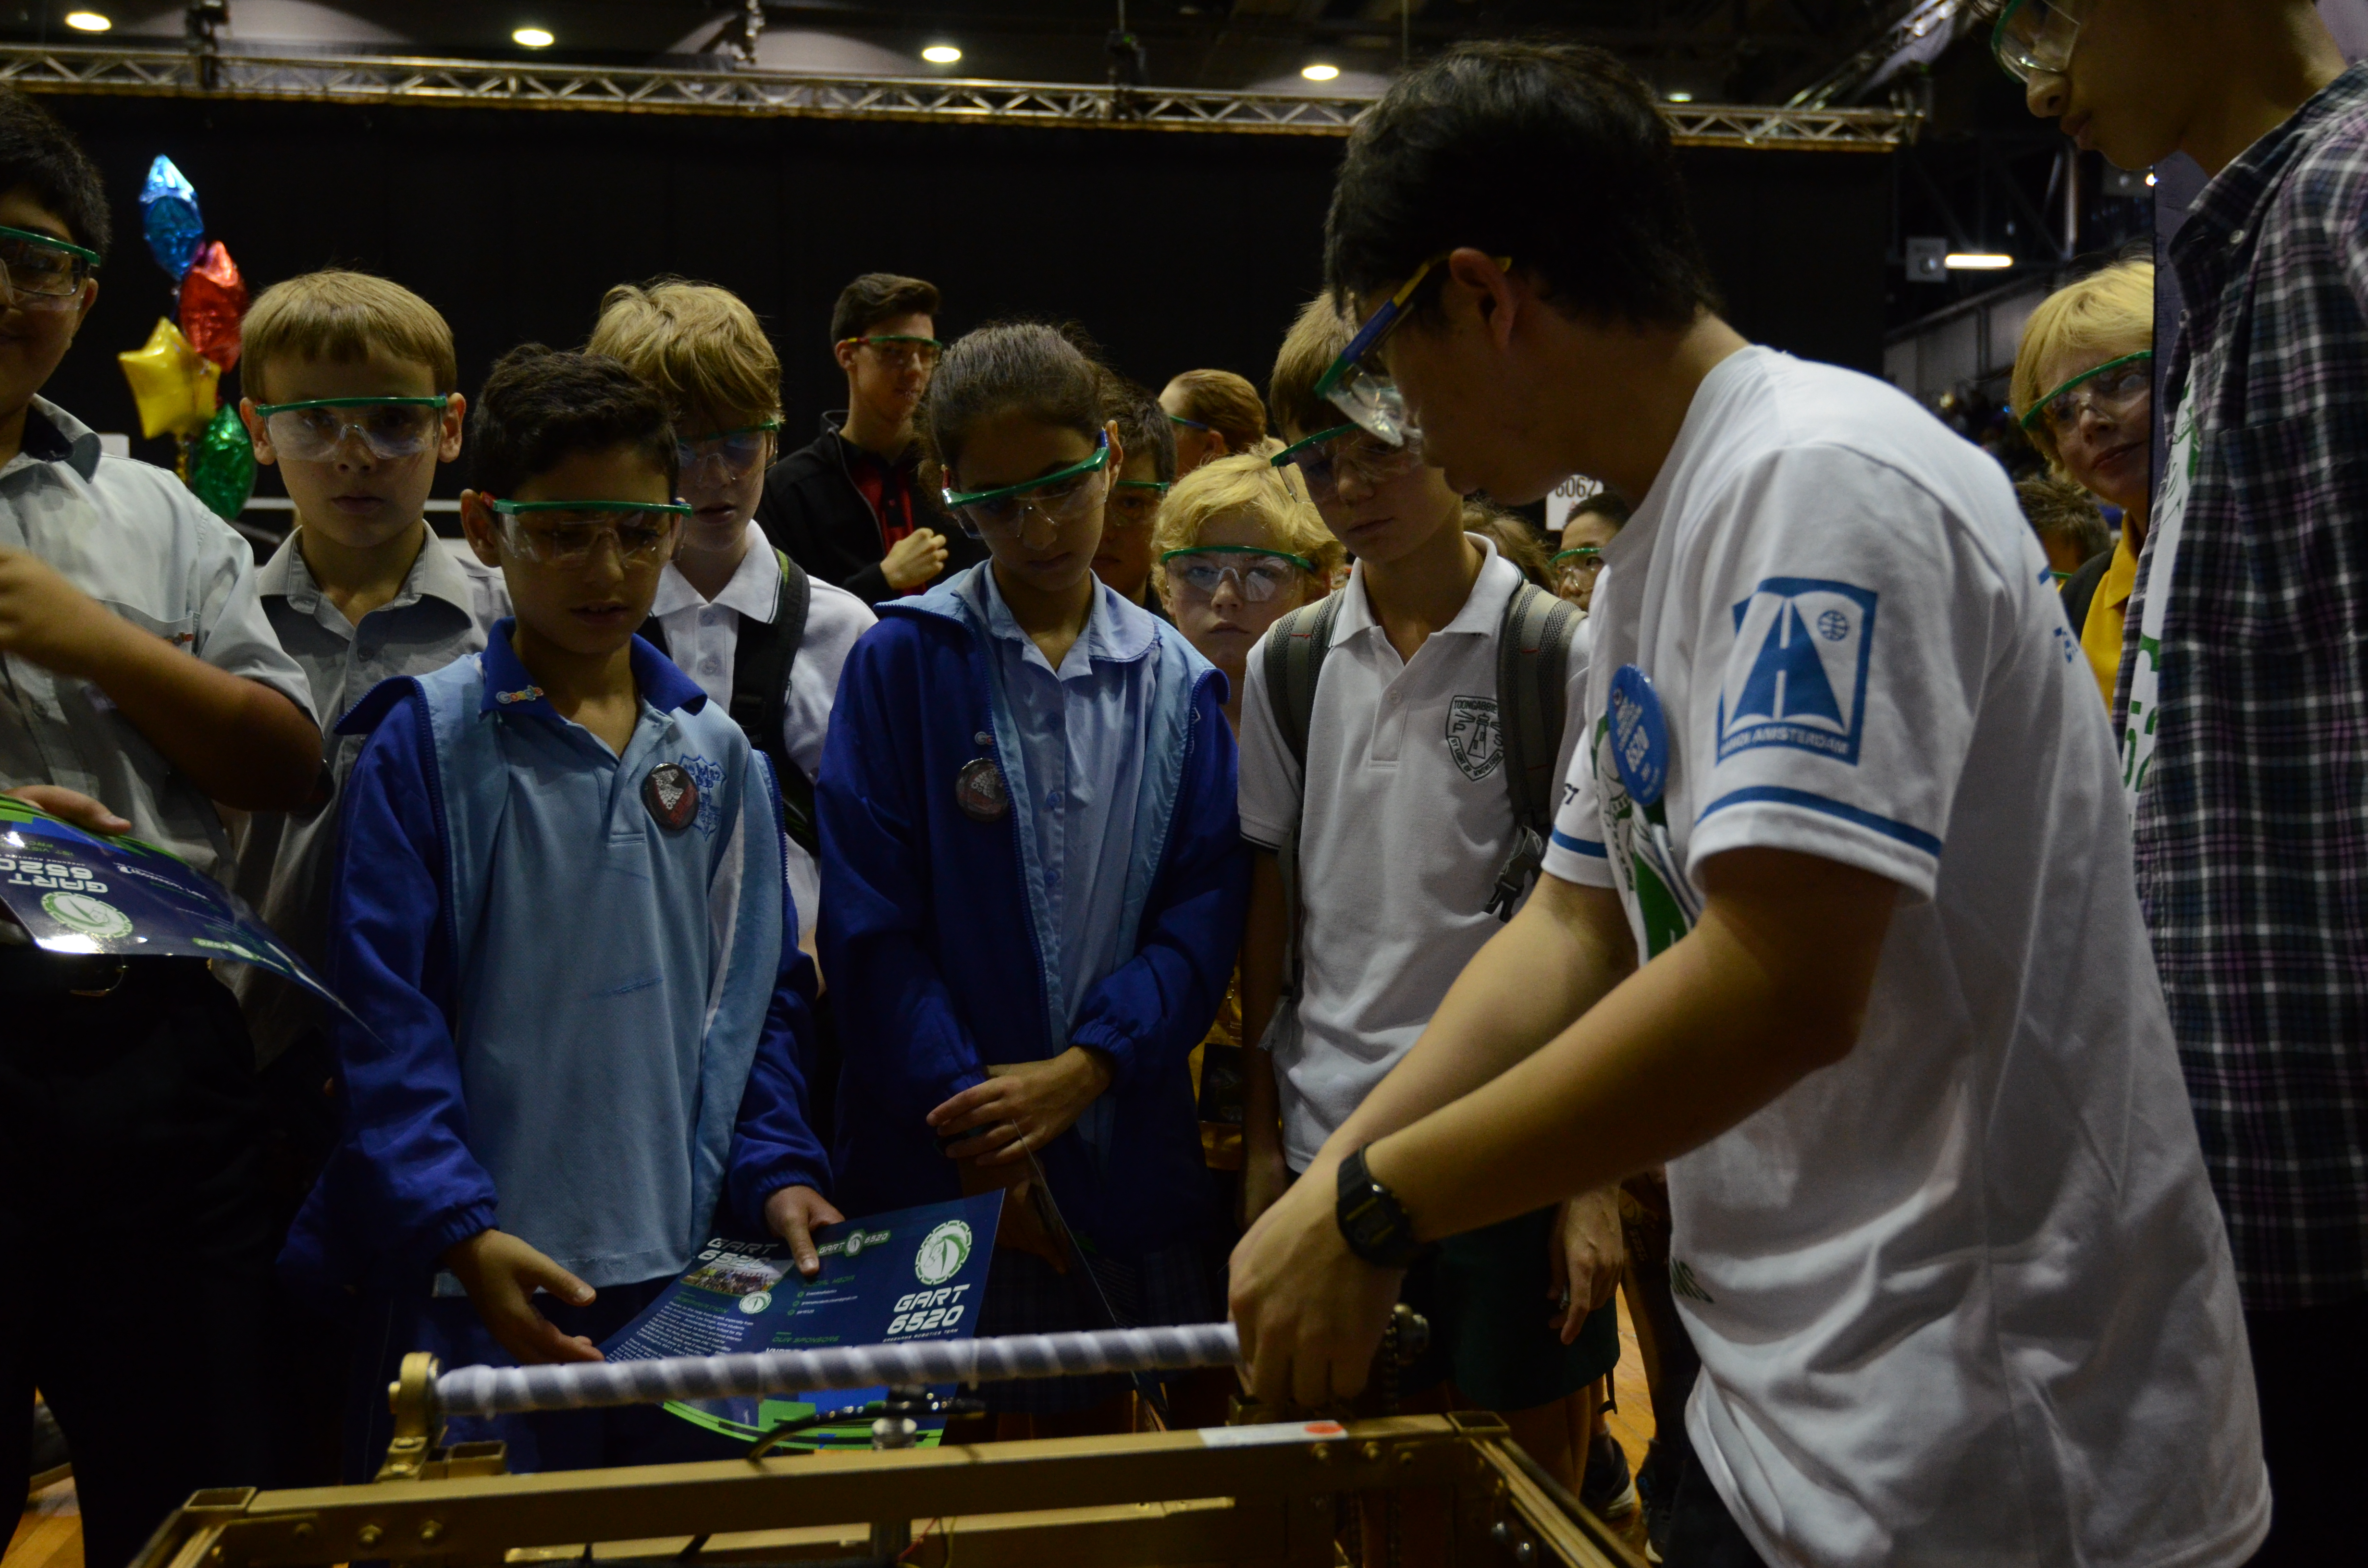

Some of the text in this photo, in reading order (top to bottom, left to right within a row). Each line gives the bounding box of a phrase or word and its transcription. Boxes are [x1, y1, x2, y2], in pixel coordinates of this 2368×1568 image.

[1454, 700, 1498, 714] TOONGABBIE
[7, 872, 108, 894] GART
[707, 1237, 780, 1255] GART
[864, 1232, 888, 1244] 6520
[819, 1242, 845, 1254] GART
[698, 1249, 771, 1269] 6520
[893, 1283, 971, 1312] GART
[887, 1305, 964, 1335] 6520
[793, 1335, 840, 1343] SPONSORS
